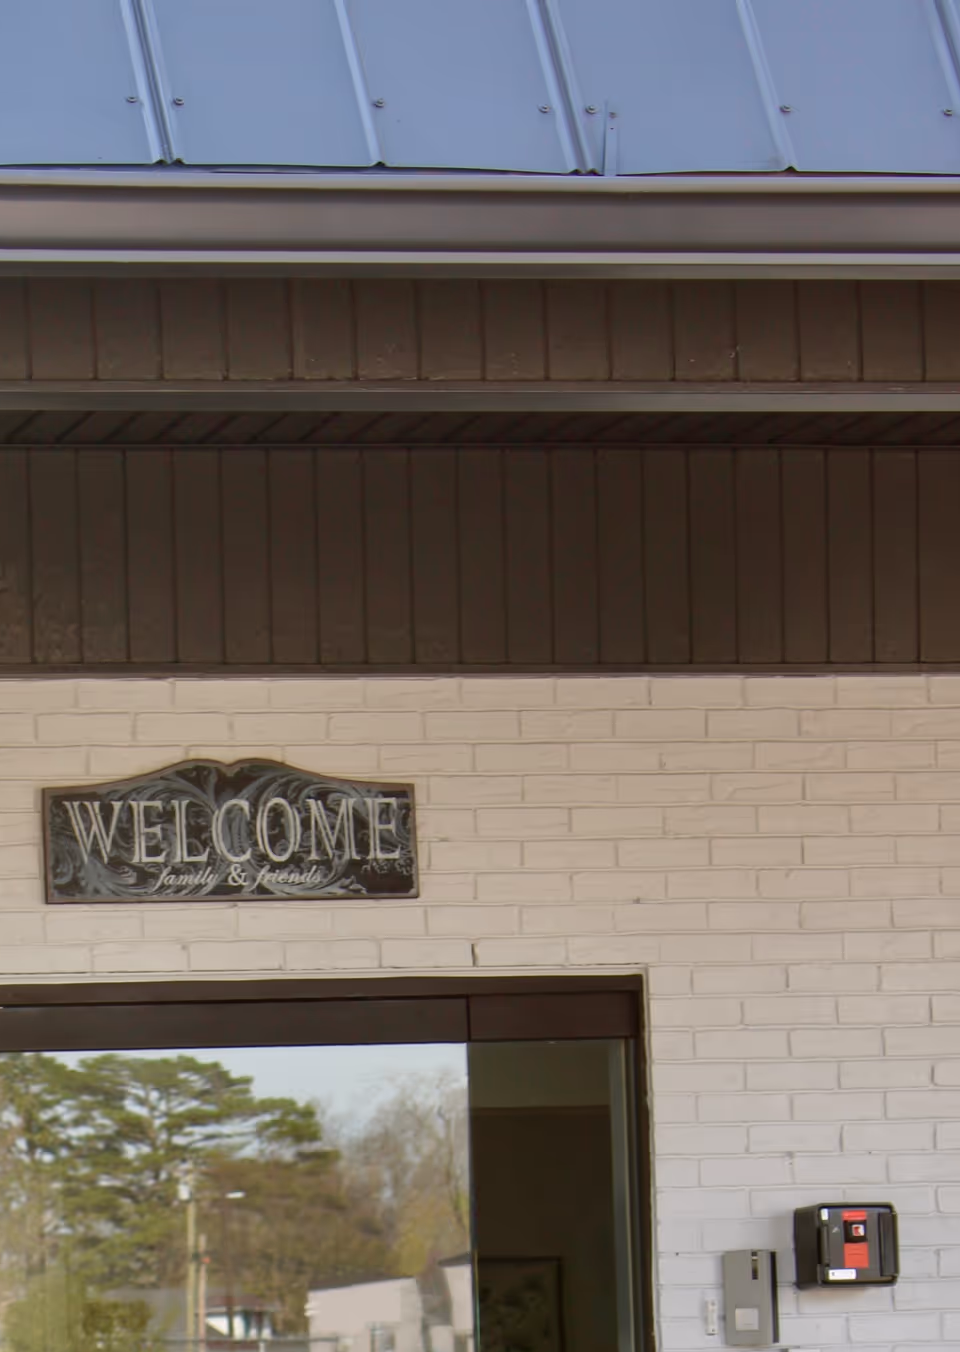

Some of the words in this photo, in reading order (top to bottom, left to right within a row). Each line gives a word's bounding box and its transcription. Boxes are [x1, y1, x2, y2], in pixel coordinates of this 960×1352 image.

[62, 796, 402, 865] WELCOME
[153, 865, 219, 893] family
[227, 864, 248, 887] &
[250, 863, 323, 893] friends
